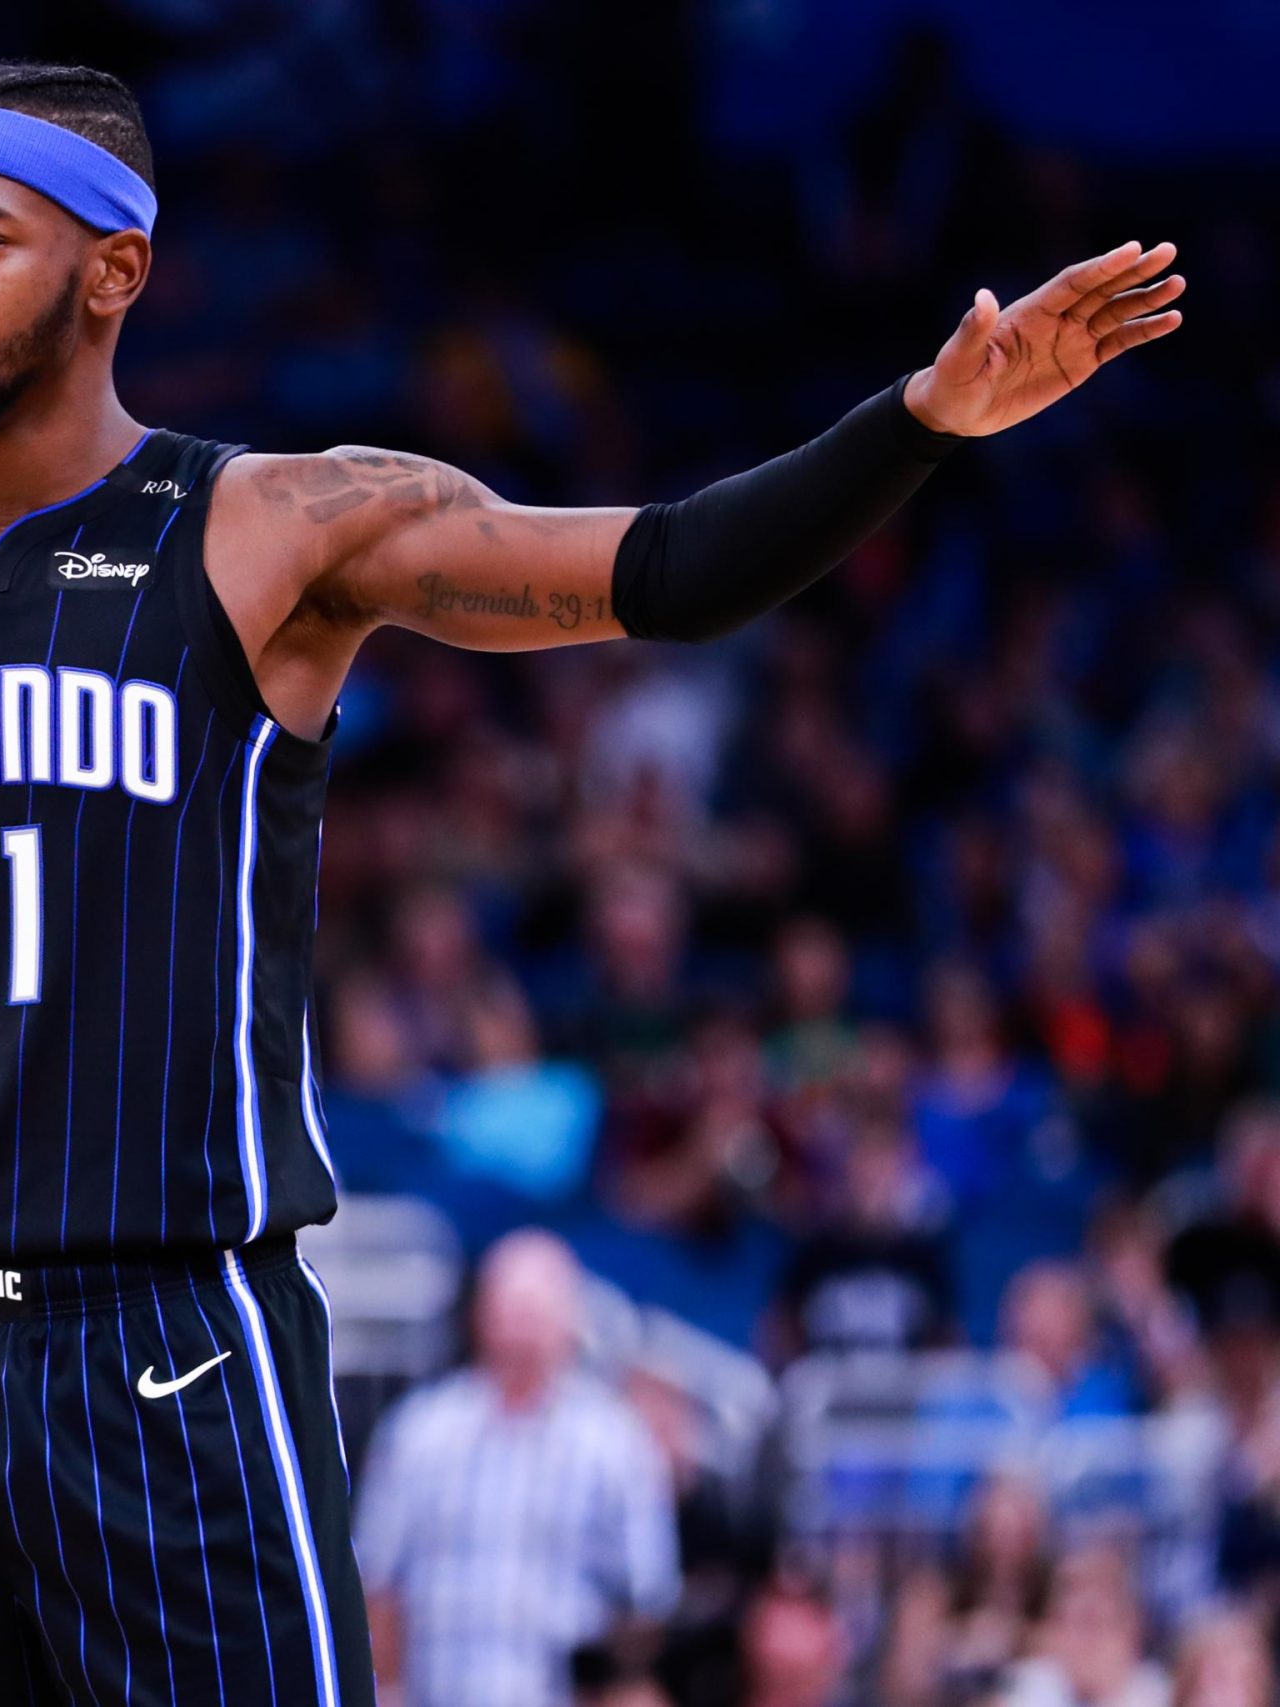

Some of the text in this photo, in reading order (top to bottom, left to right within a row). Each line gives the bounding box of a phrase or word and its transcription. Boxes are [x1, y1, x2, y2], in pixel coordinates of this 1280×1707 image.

[140, 479, 188, 500] RDV
[417, 572, 616, 630] Jeremiah 29:1
